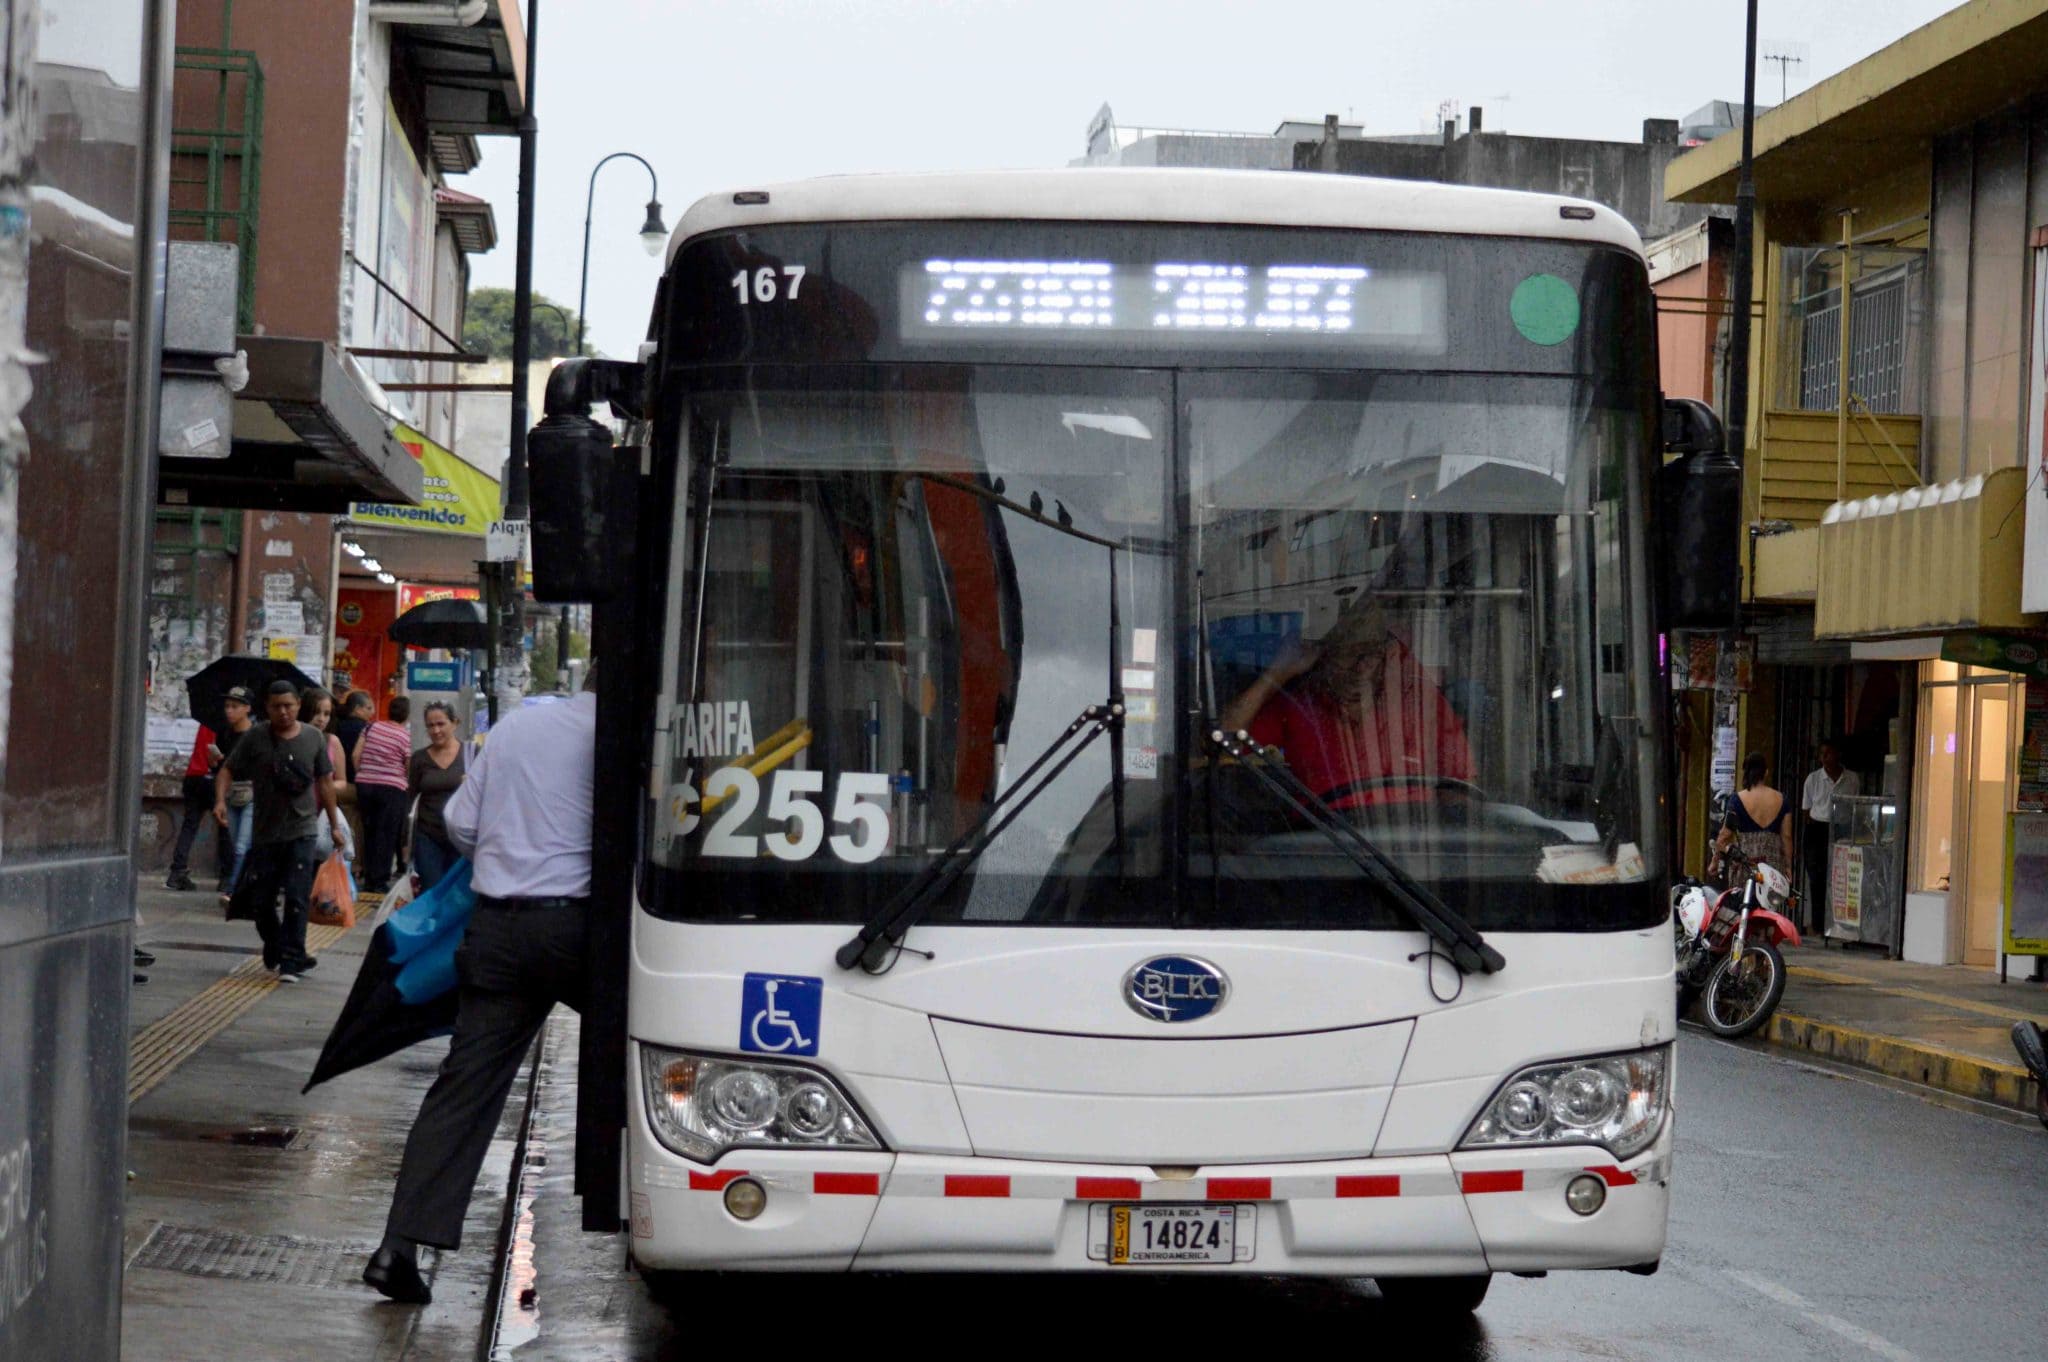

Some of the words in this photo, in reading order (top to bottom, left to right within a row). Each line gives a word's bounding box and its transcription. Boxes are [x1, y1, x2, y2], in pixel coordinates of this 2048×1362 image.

[732, 265, 806, 305] 167
[355, 502, 467, 526] Bienvenidos
[671, 700, 755, 757] TARIFA
[1143, 973, 1209, 999] BLK
[1144, 1209, 1175, 1218] COSTA
[1179, 1209, 1200, 1217] RICA
[1142, 1219, 1220, 1250] 14824
[1132, 1252, 1211, 1261] CENTROAMERICA
